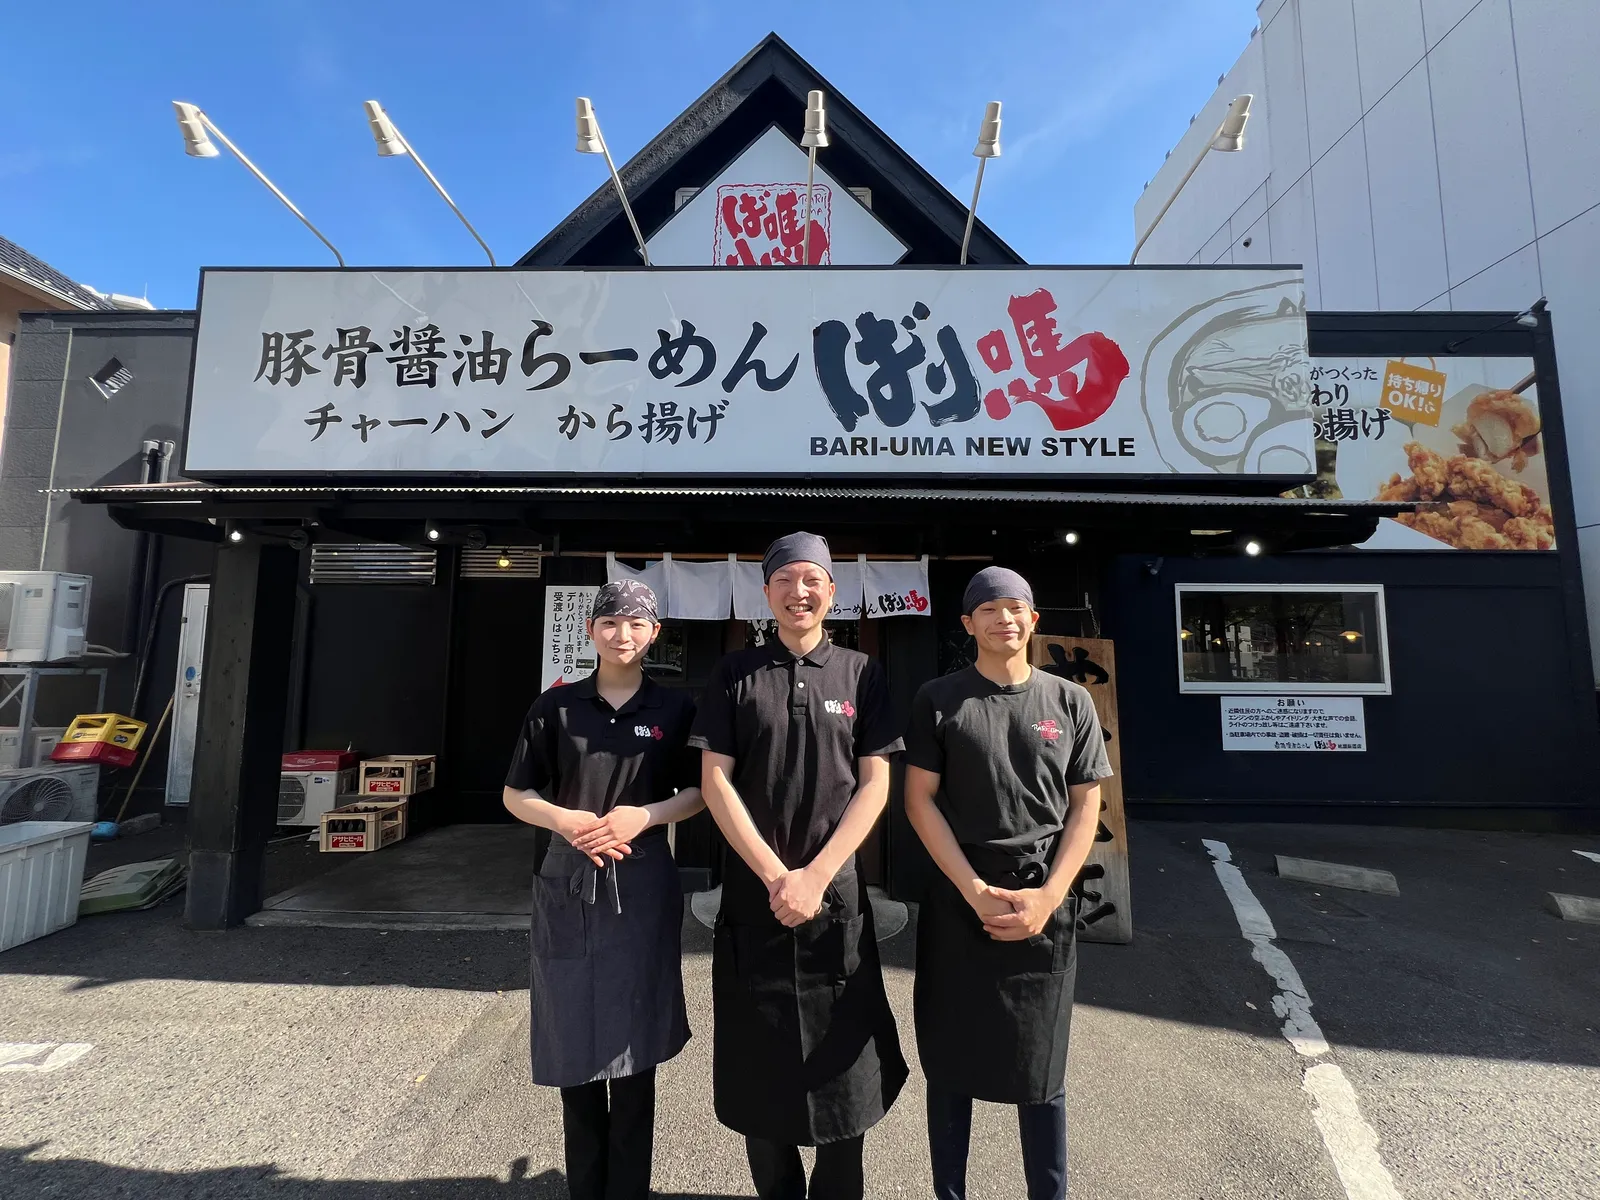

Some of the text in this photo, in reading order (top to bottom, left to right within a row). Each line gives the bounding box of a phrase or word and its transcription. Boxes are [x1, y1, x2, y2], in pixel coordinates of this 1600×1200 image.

[253, 319, 800, 393] 豚骨醤油らーめん
[1310, 365, 1378, 381] がつくった
[1311, 383, 1349, 407] わり
[1387, 373, 1442, 398] 持ち帰り
[304, 399, 730, 445] チャーハン から揚げ
[810, 437, 1136, 457] BARI-UMA NEW STYLE
[829, 603, 878, 615] らーめん
[552, 591, 564, 665] 受渡しはこちら
[563, 592, 577, 675] デリバリー商品の
[1277, 699, 1306, 707] お願い
